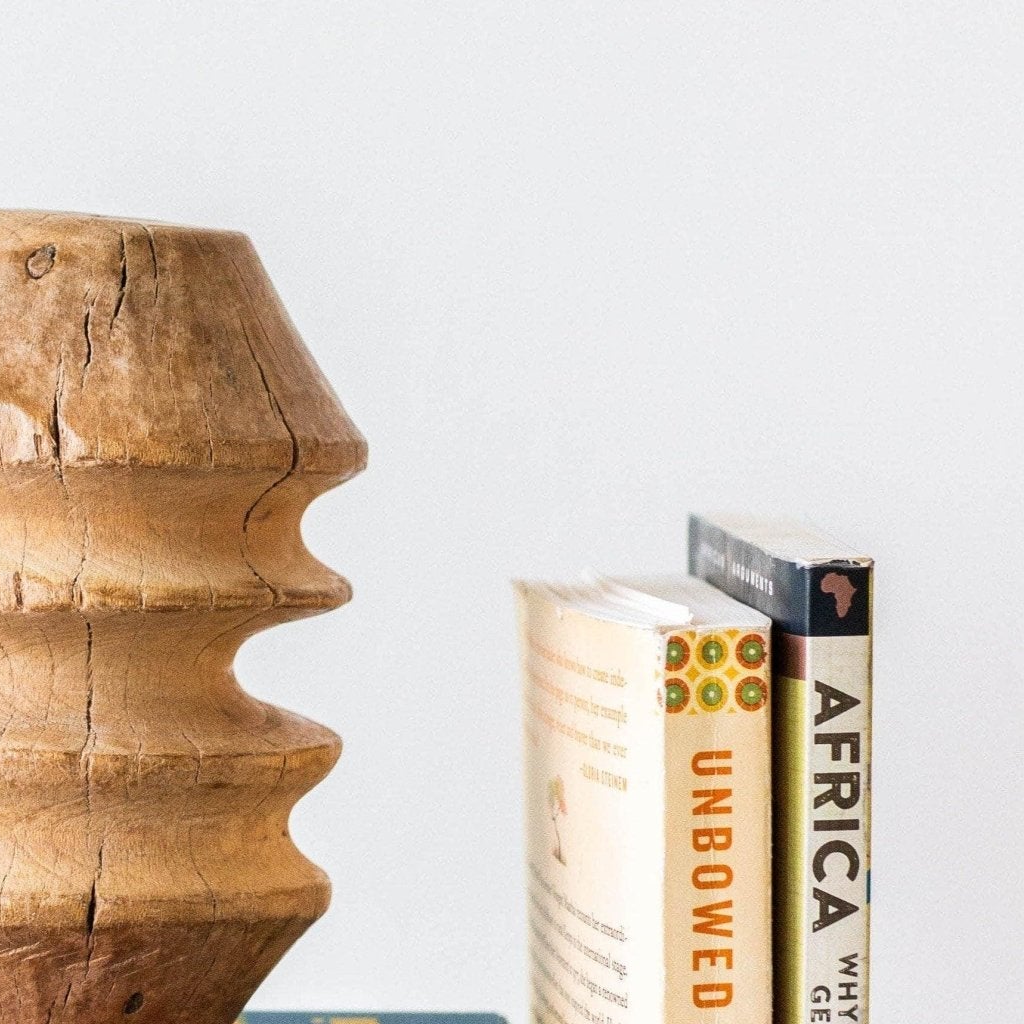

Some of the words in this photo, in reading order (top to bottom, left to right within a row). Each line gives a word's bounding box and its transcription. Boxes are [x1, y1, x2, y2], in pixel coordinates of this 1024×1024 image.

[692, 751, 733, 1008] UNBOWED
[813, 681, 860, 932] AFRICA
[838, 953, 857, 1021] WHY
